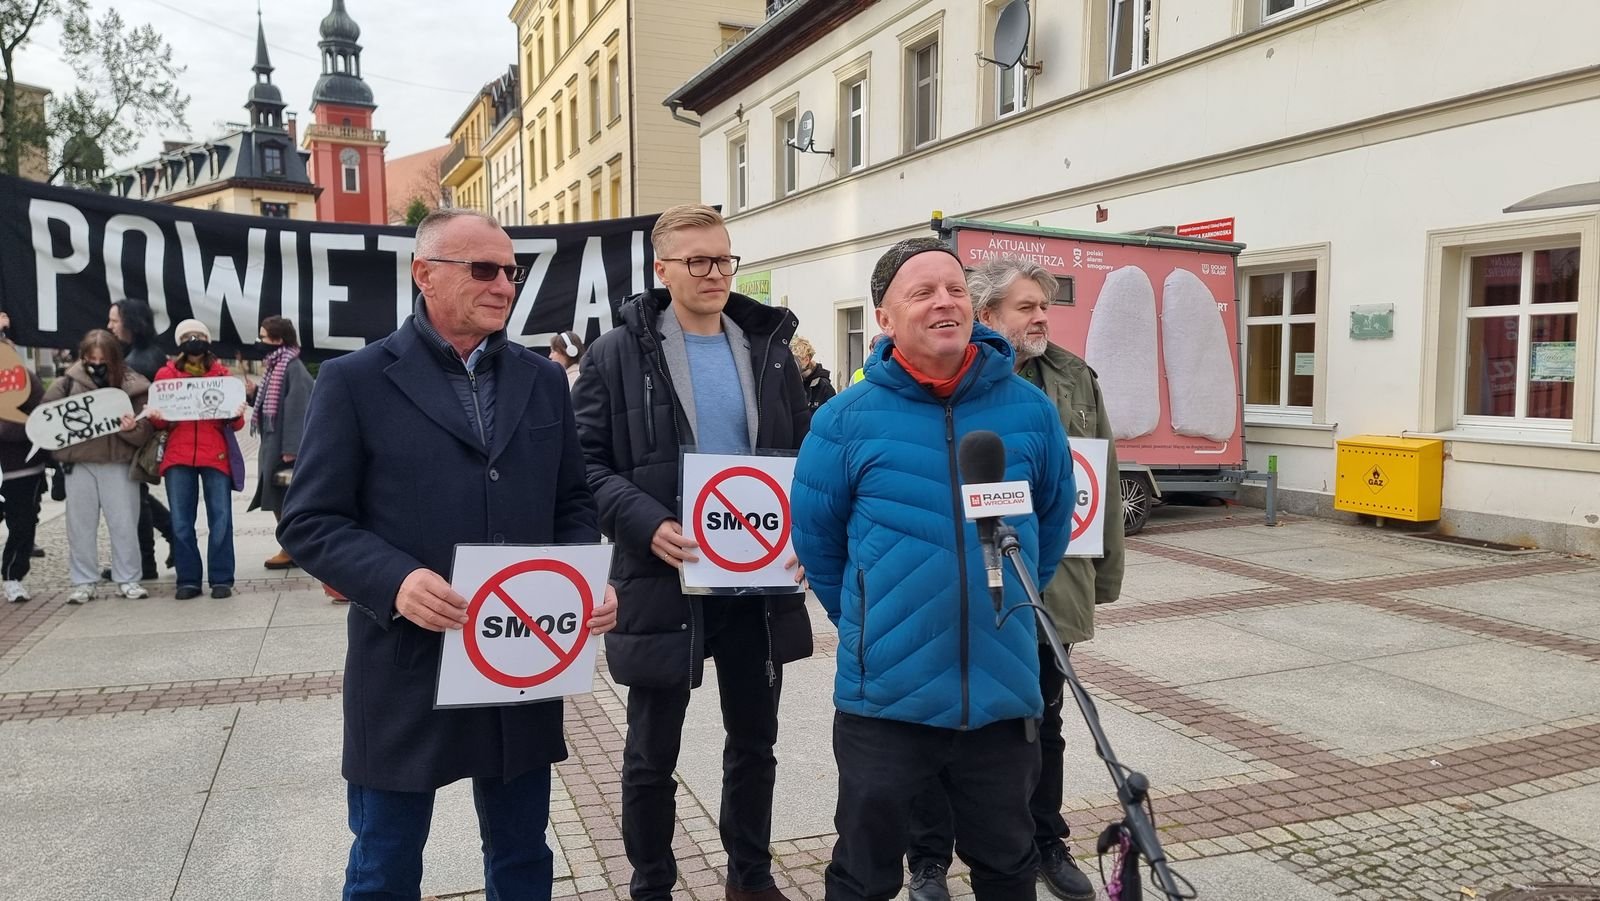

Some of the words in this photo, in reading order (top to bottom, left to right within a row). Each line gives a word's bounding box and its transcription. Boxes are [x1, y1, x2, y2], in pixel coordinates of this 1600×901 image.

[989, 238, 1046, 254] AKTUALNY
[969, 249, 999, 262] STAN
[1086, 263, 1114, 271] smogowy
[29, 198, 646, 351] POWIETZA!
[155, 381, 183, 393] STOP
[42, 395, 95, 422] STOP
[1368, 478, 1384, 487] GAZ
[982, 491, 1025, 501] RADIO
[706, 511, 779, 531] SMOG
[482, 612, 577, 639] SMOG
